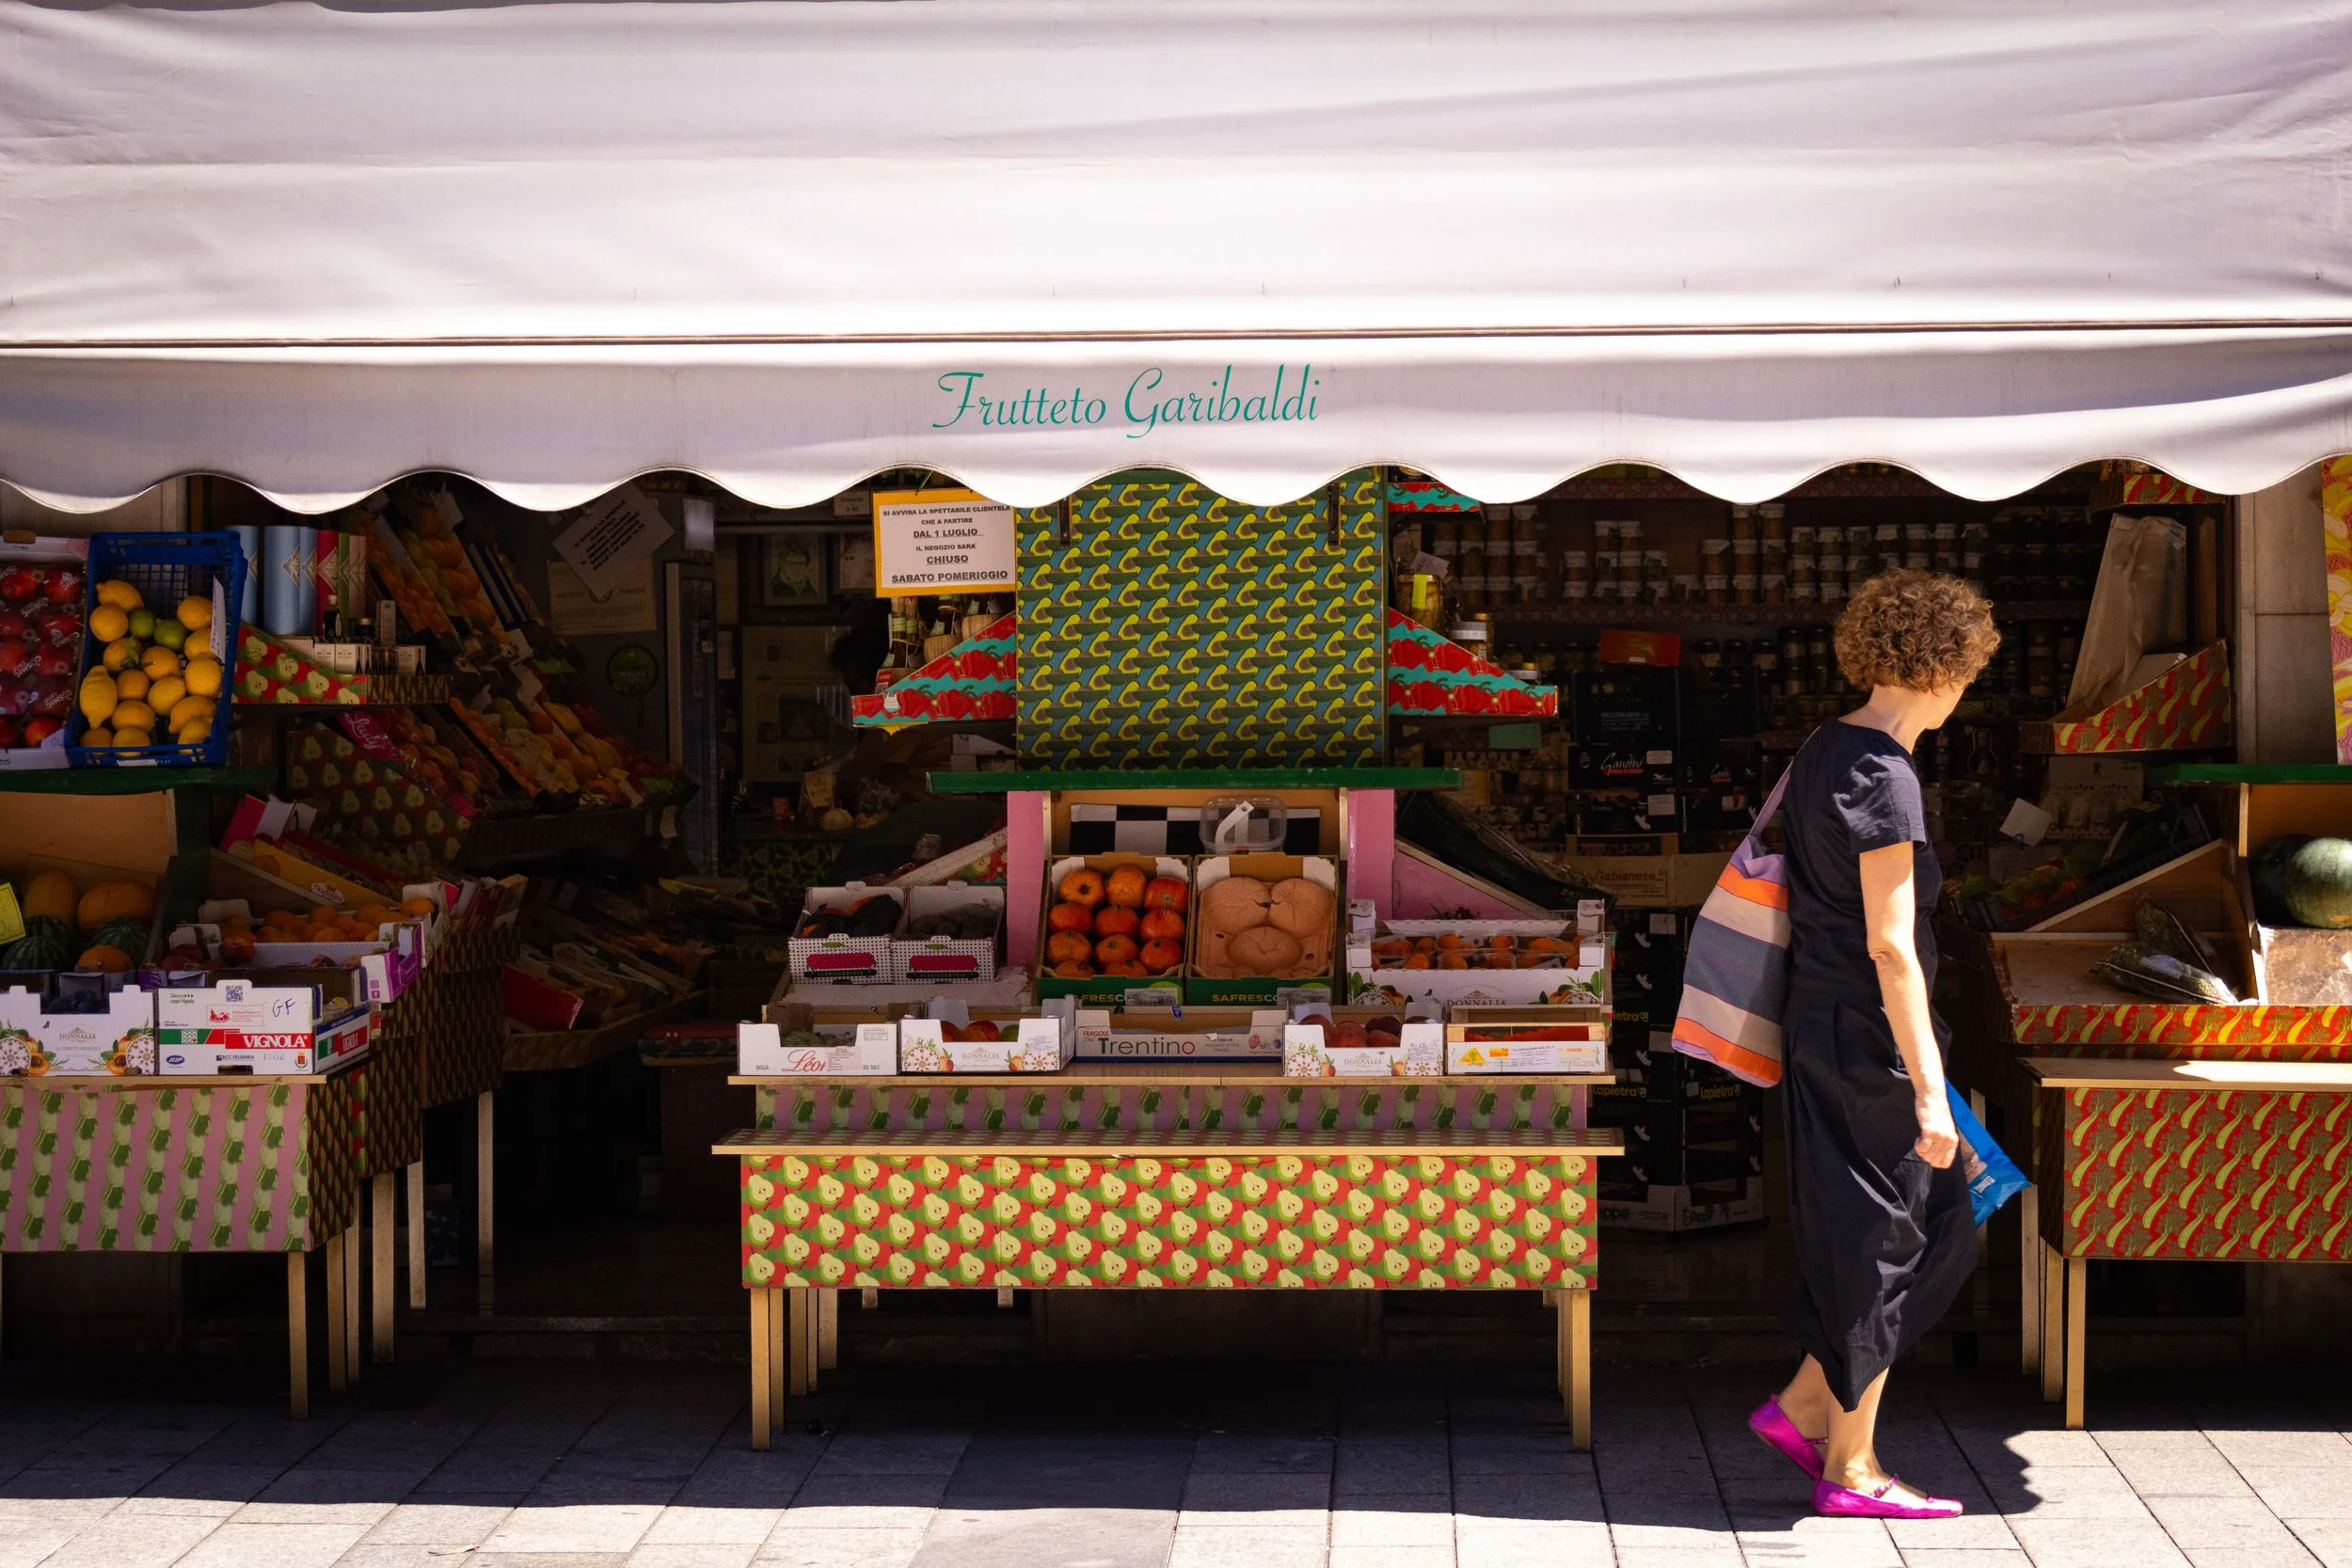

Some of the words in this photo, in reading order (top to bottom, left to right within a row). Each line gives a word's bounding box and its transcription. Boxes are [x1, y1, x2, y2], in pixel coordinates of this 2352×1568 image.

[932, 372, 1106, 428] Frutteto
[1124, 363, 1320, 438] Garibaldi
[934, 530, 939, 538] 1
[943, 528, 977, 537] LUGLIO
[927, 555, 969, 564] CHIUSO
[892, 574, 935, 583] SABATO
[938, 570, 1009, 581] POMERIGGIO
[1081, 994, 1125, 1003] FRESC
[244, 1035, 306, 1048] VIGNOLA
[1098, 1037, 1196, 1054] Trentino
